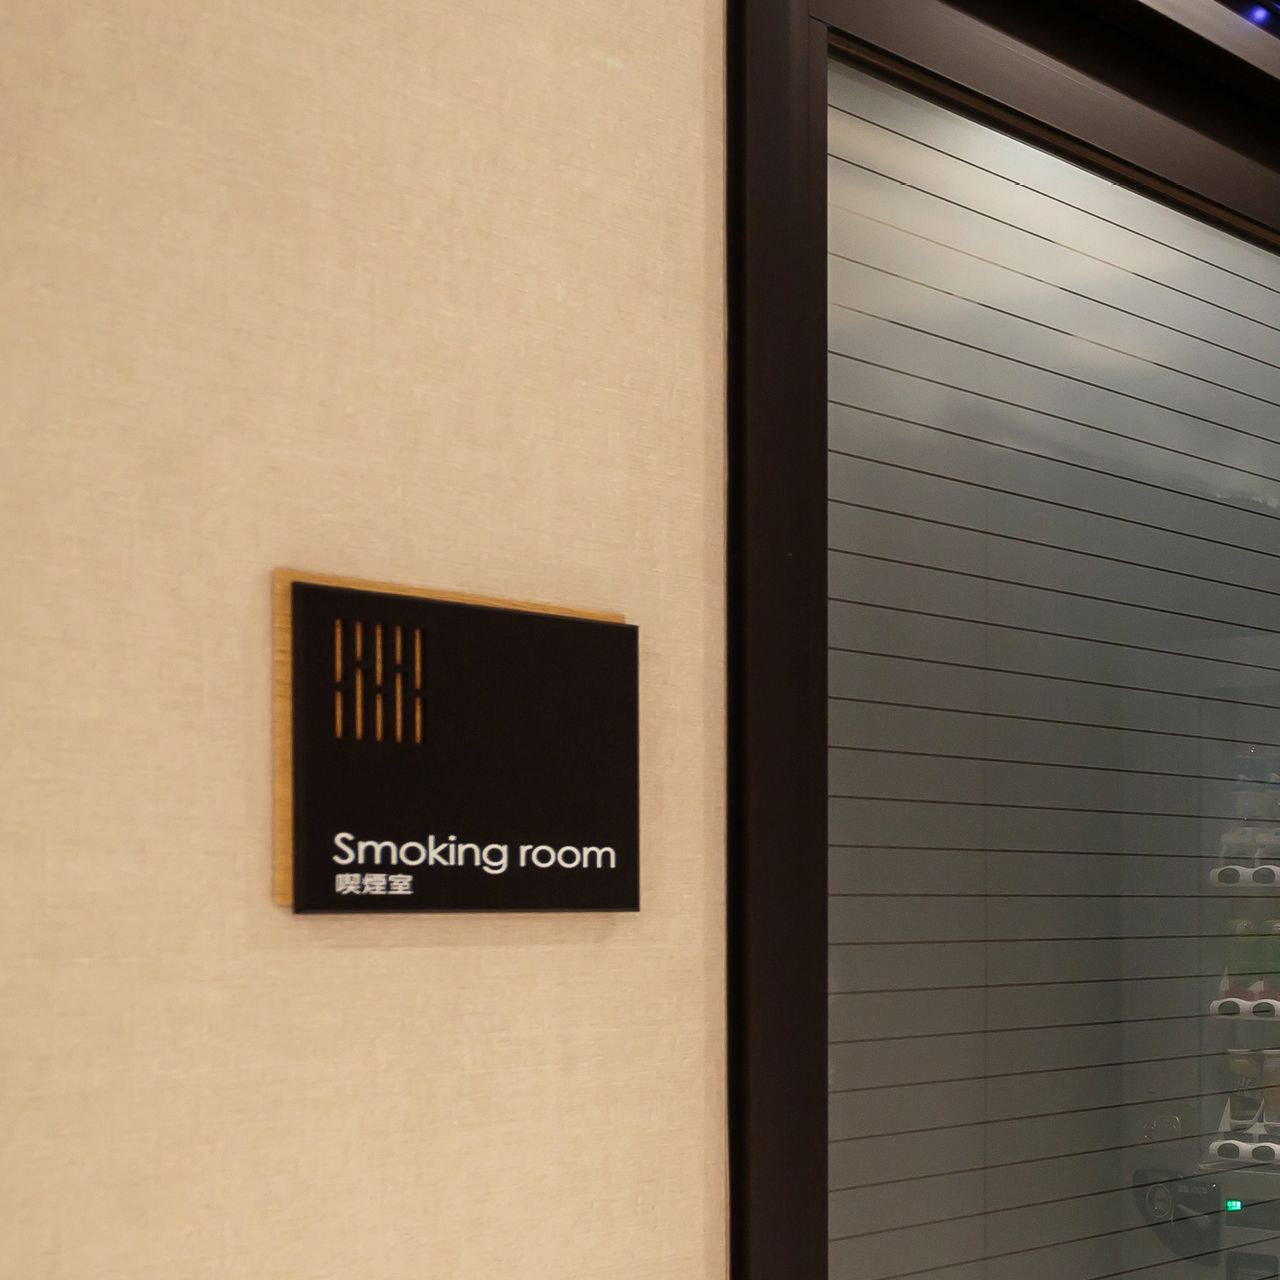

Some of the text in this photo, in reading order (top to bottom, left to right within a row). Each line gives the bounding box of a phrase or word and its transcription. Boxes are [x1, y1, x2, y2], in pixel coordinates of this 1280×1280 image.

[332, 832, 616, 874] Smoking room
[335, 873, 413, 895] 喫煙室
